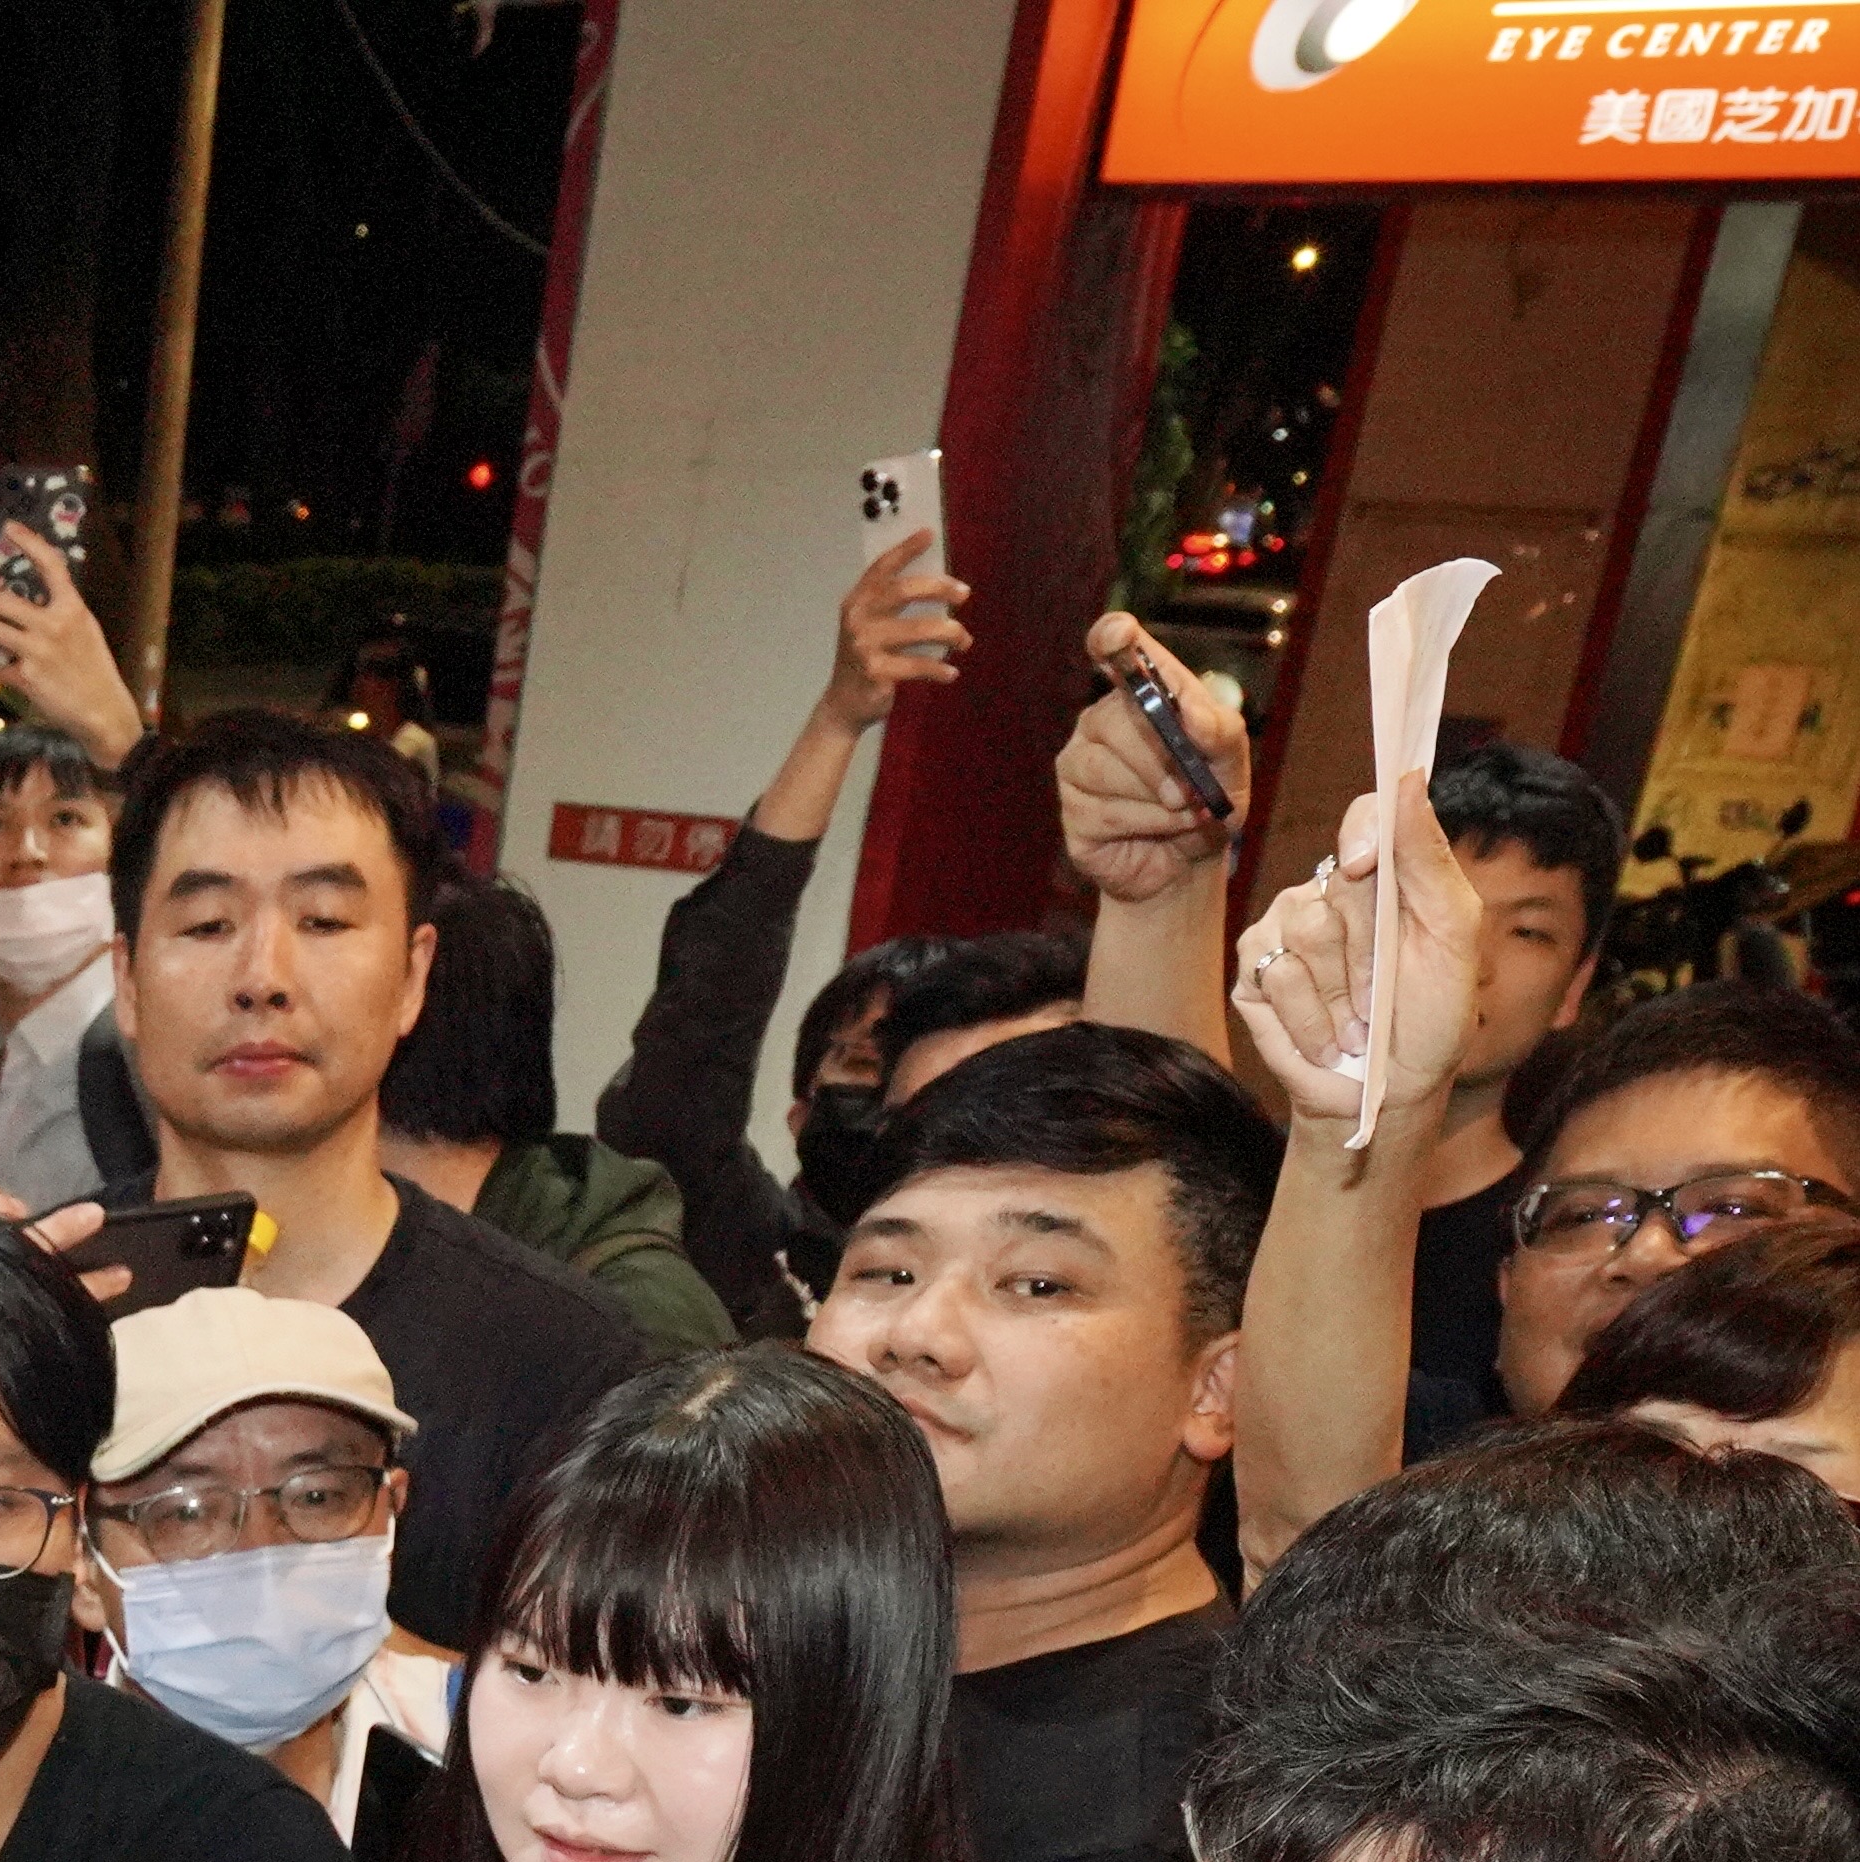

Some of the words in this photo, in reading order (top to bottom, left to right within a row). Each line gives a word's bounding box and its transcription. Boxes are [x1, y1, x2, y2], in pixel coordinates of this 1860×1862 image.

[1487, 26, 1593, 62] EYE
[1605, 19, 1830, 59] CENTER
[1579, 85, 1860, 145] 美國芝加
